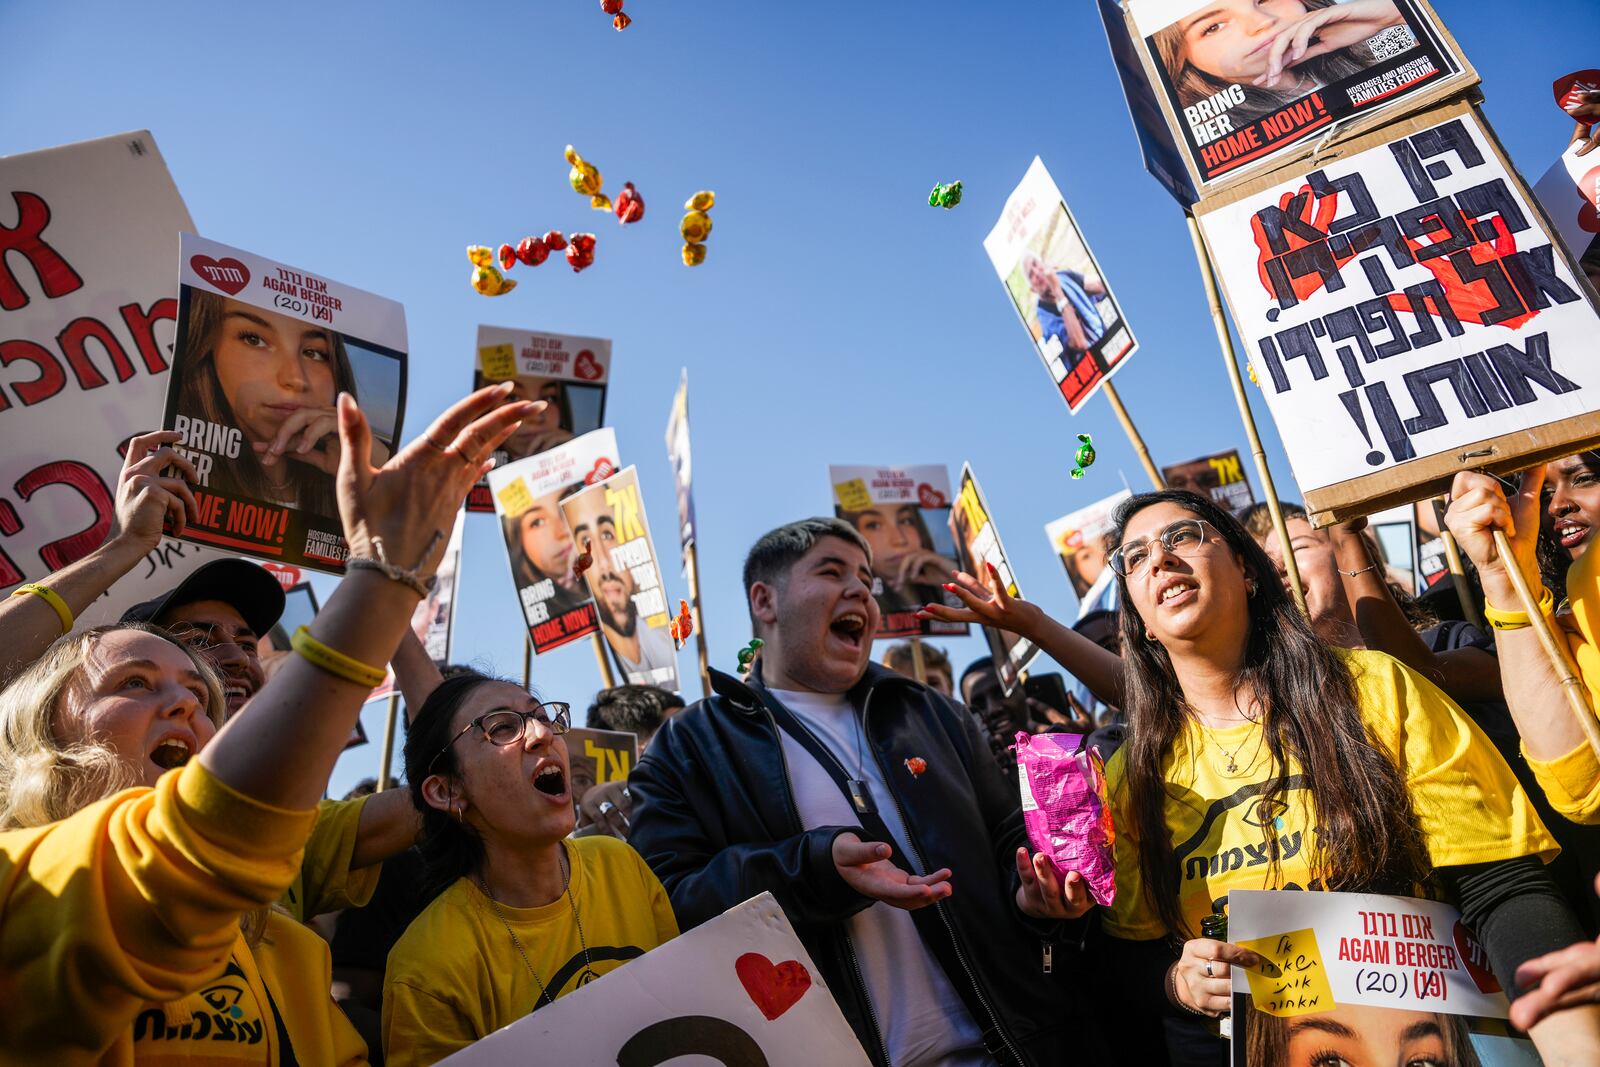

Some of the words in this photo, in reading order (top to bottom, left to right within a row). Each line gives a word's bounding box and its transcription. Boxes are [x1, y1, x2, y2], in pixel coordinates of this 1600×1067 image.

[1346, 76, 1382, 96] HOSTAGES
[1382, 70, 1397, 83] AND
[1398, 55, 1430, 75] MISSING
[1349, 79, 1397, 105] FAMILIES
[1396, 61, 1436, 86] FORUM
[1183, 83, 1246, 126] BRING
[1191, 114, 1235, 147] HER
[1200, 124, 1262, 169] HOME
[1260, 92, 1327, 140] NOW!
[1388, 118, 1486, 204] הן
[1256, 169, 1381, 256] לא
[203, 265, 245, 283] חזרתי
[276, 267, 302, 286] ברגר
[306, 277, 328, 294] אגם
[1450, 244, 1582, 327] אל
[263, 276, 298, 297] AGAM
[300, 286, 343, 311] BERGER
[274, 294, 309, 315] (20)
[1258, 278, 1466, 394] תפקירו
[1338, 331, 1582, 467] אותן!
[174, 414, 243, 460] BRING
[1208, 455, 1243, 485] אל
[226, 500, 289, 544] NOW!
[307, 529, 339, 545] HOSTAGES
[304, 540, 343, 560] FAMILIES
[520, 578, 555, 605] BRING
[524, 602, 550, 626] HER
[530, 617, 565, 646] HOME
[562, 602, 596, 632] NOW!
[584, 739, 629, 785] אל
[1186, 830, 1303, 881] עוצמות
[1358, 911, 1398, 938] ברגר
[1402, 914, 1435, 940] אגם
[1338, 937, 1390, 965] AGAM
[1395, 941, 1459, 970] BERGER
[1355, 968, 1408, 999] (20)
